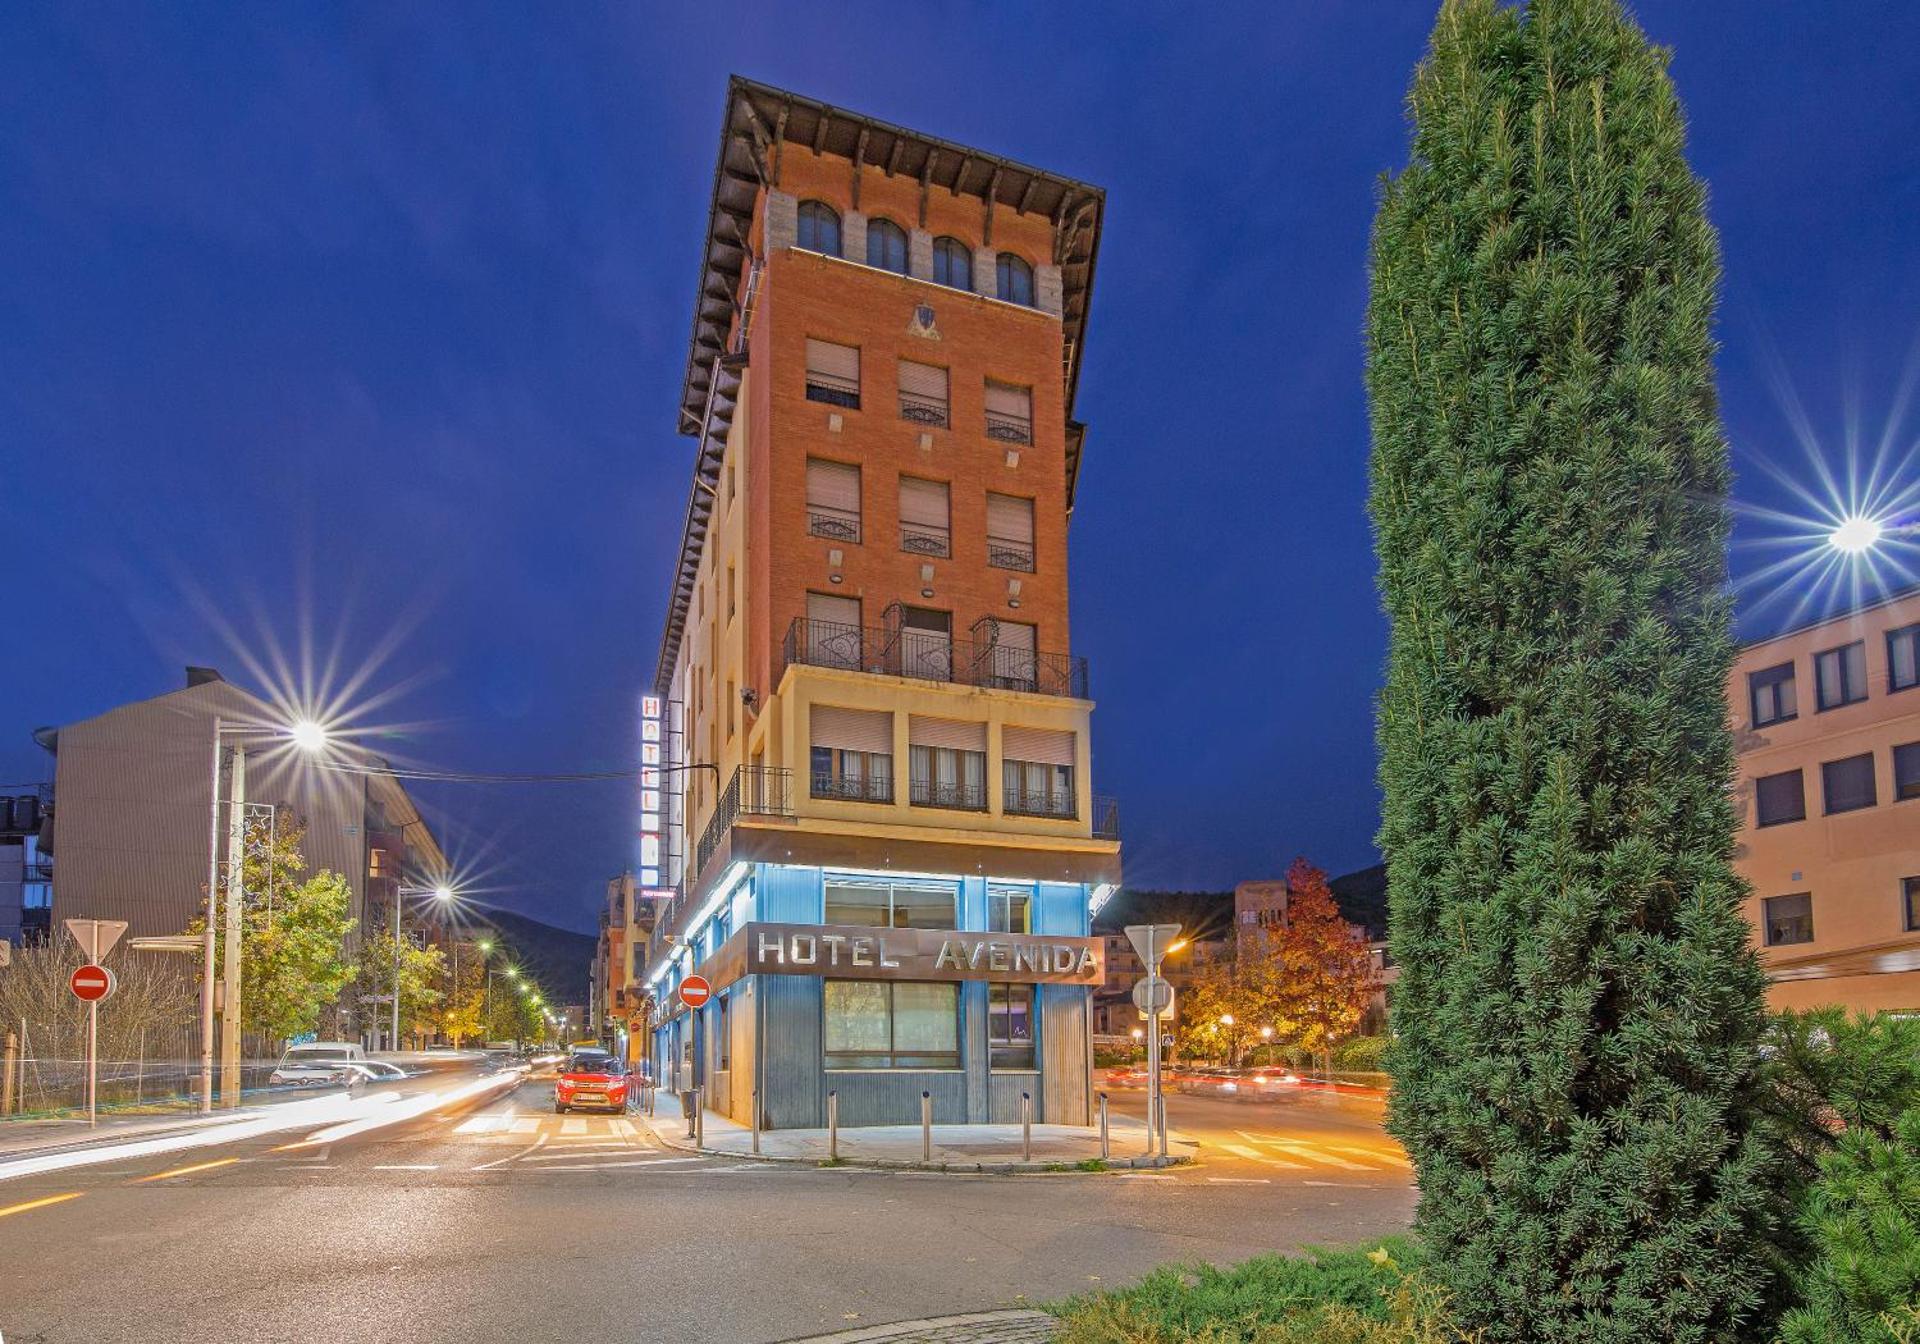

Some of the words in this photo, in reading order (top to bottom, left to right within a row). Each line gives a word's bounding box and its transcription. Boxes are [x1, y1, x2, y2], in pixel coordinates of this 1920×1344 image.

[643, 699, 658, 809] HOTEL
[757, 932, 900, 968] HOTEL
[935, 940, 1099, 974] AVENIDA
